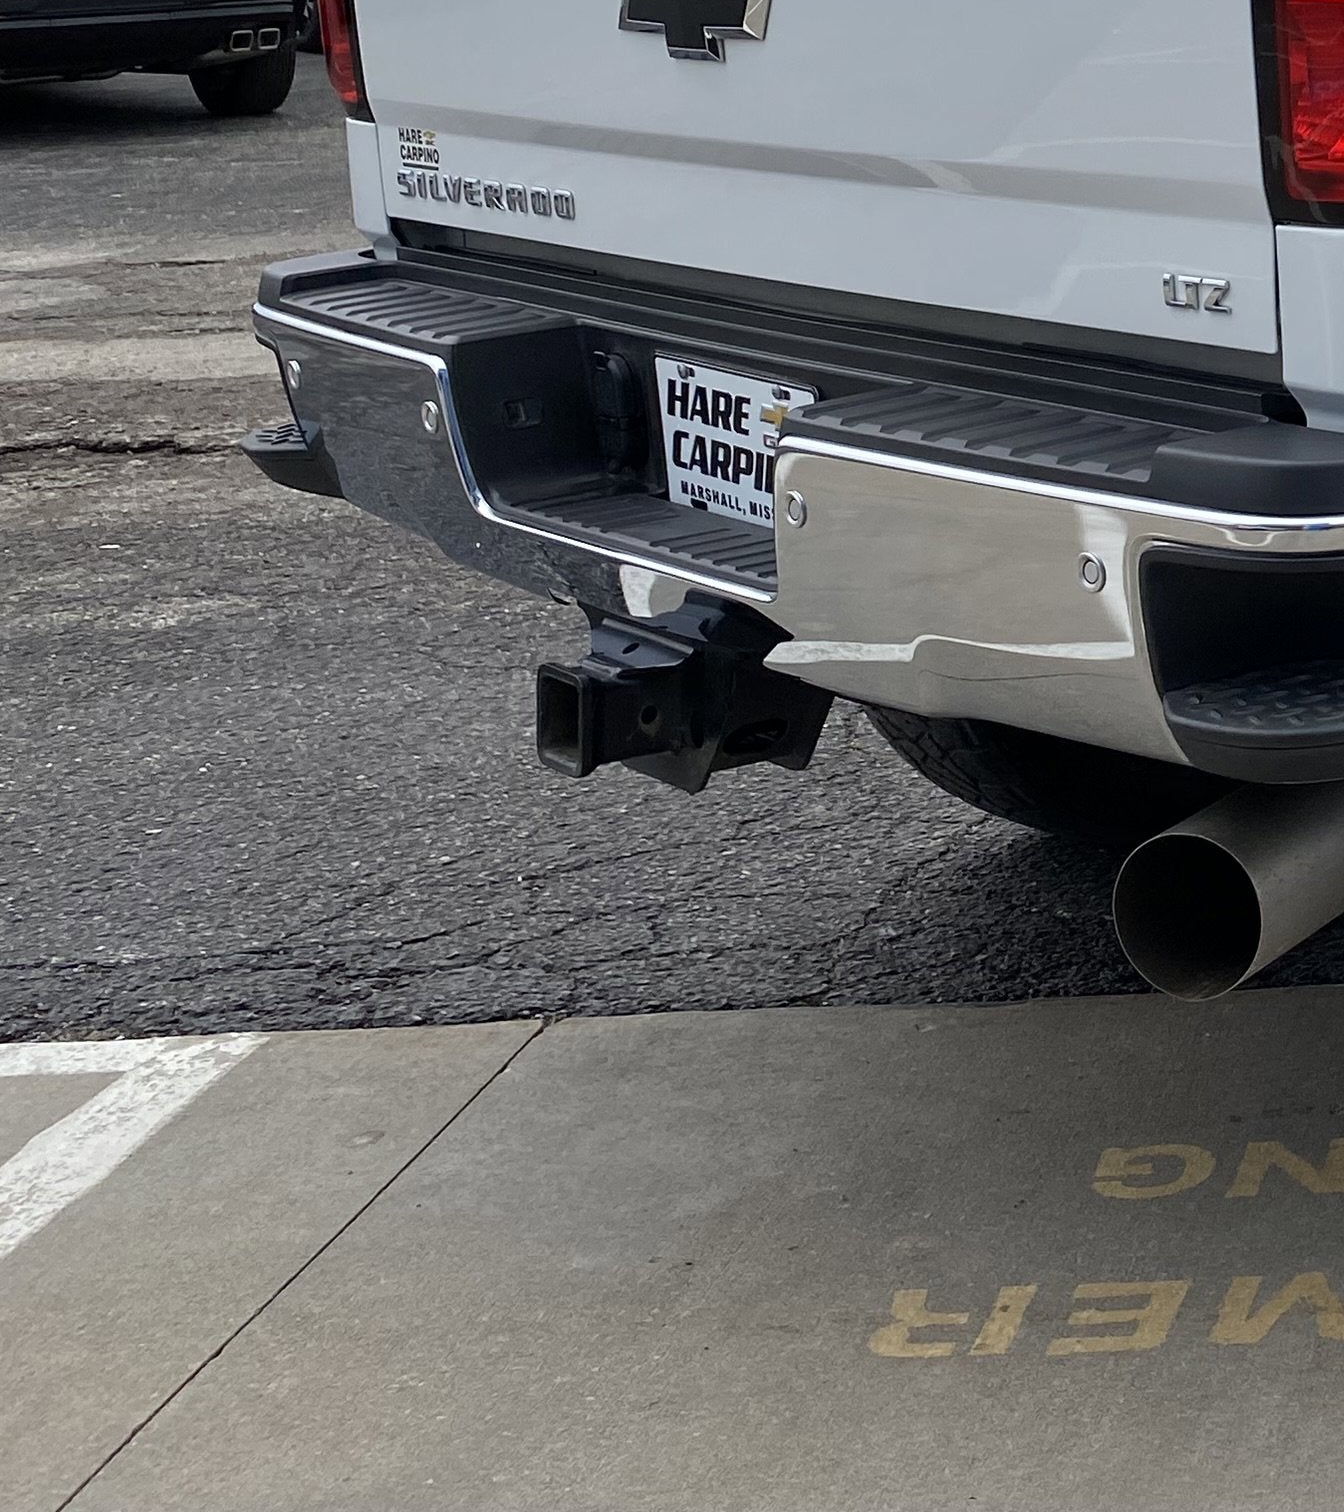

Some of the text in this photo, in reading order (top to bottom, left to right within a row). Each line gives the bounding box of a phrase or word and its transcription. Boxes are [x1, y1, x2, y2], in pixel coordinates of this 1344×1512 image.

[398, 128, 423, 145] HARE
[400, 145, 440, 164] CARPINO
[397, 169, 576, 221] SILVERADO
[1163, 273, 1232, 315] LTZ
[667, 378, 751, 435] HARE
[681, 480, 775, 521] MARSHALL, MIS
